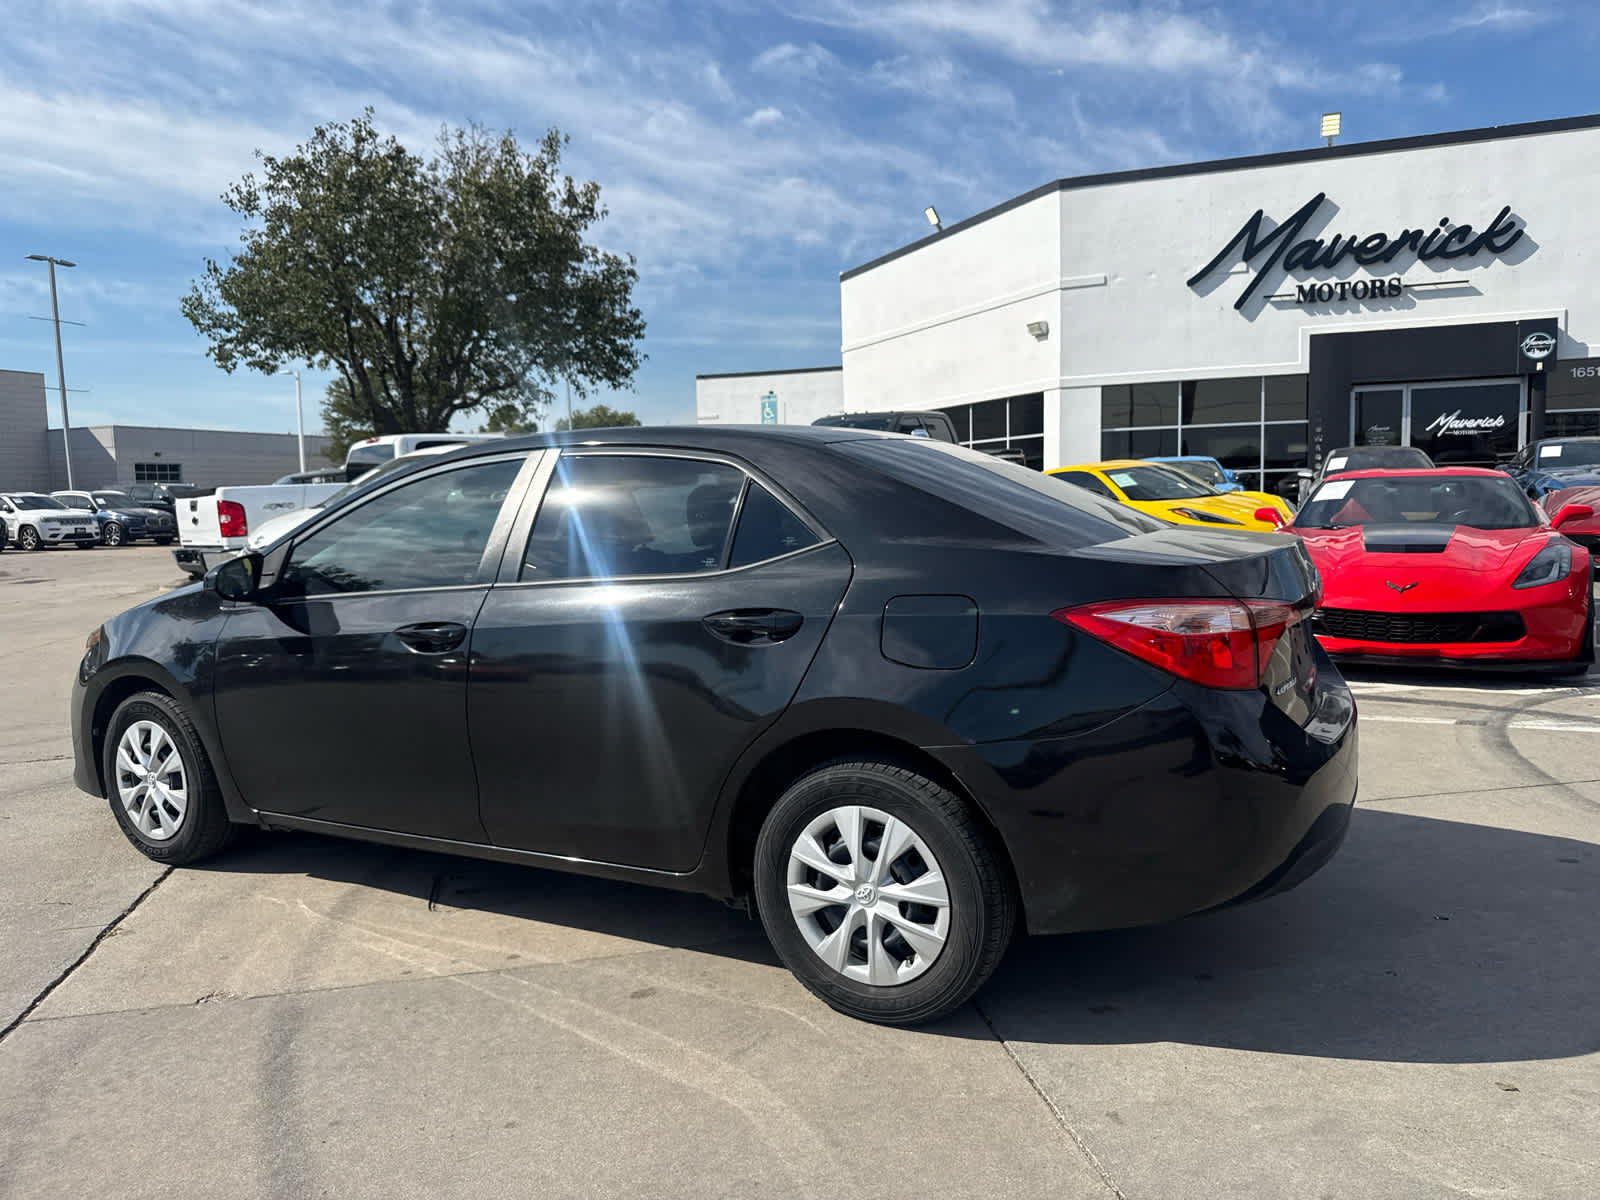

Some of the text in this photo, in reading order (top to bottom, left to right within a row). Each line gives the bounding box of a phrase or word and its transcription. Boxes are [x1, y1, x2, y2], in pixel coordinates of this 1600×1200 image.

[1186, 192, 1525, 310] Maverick
[1295, 277, 1403, 305] MOTORS
[1425, 409, 1505, 437] Maverick
